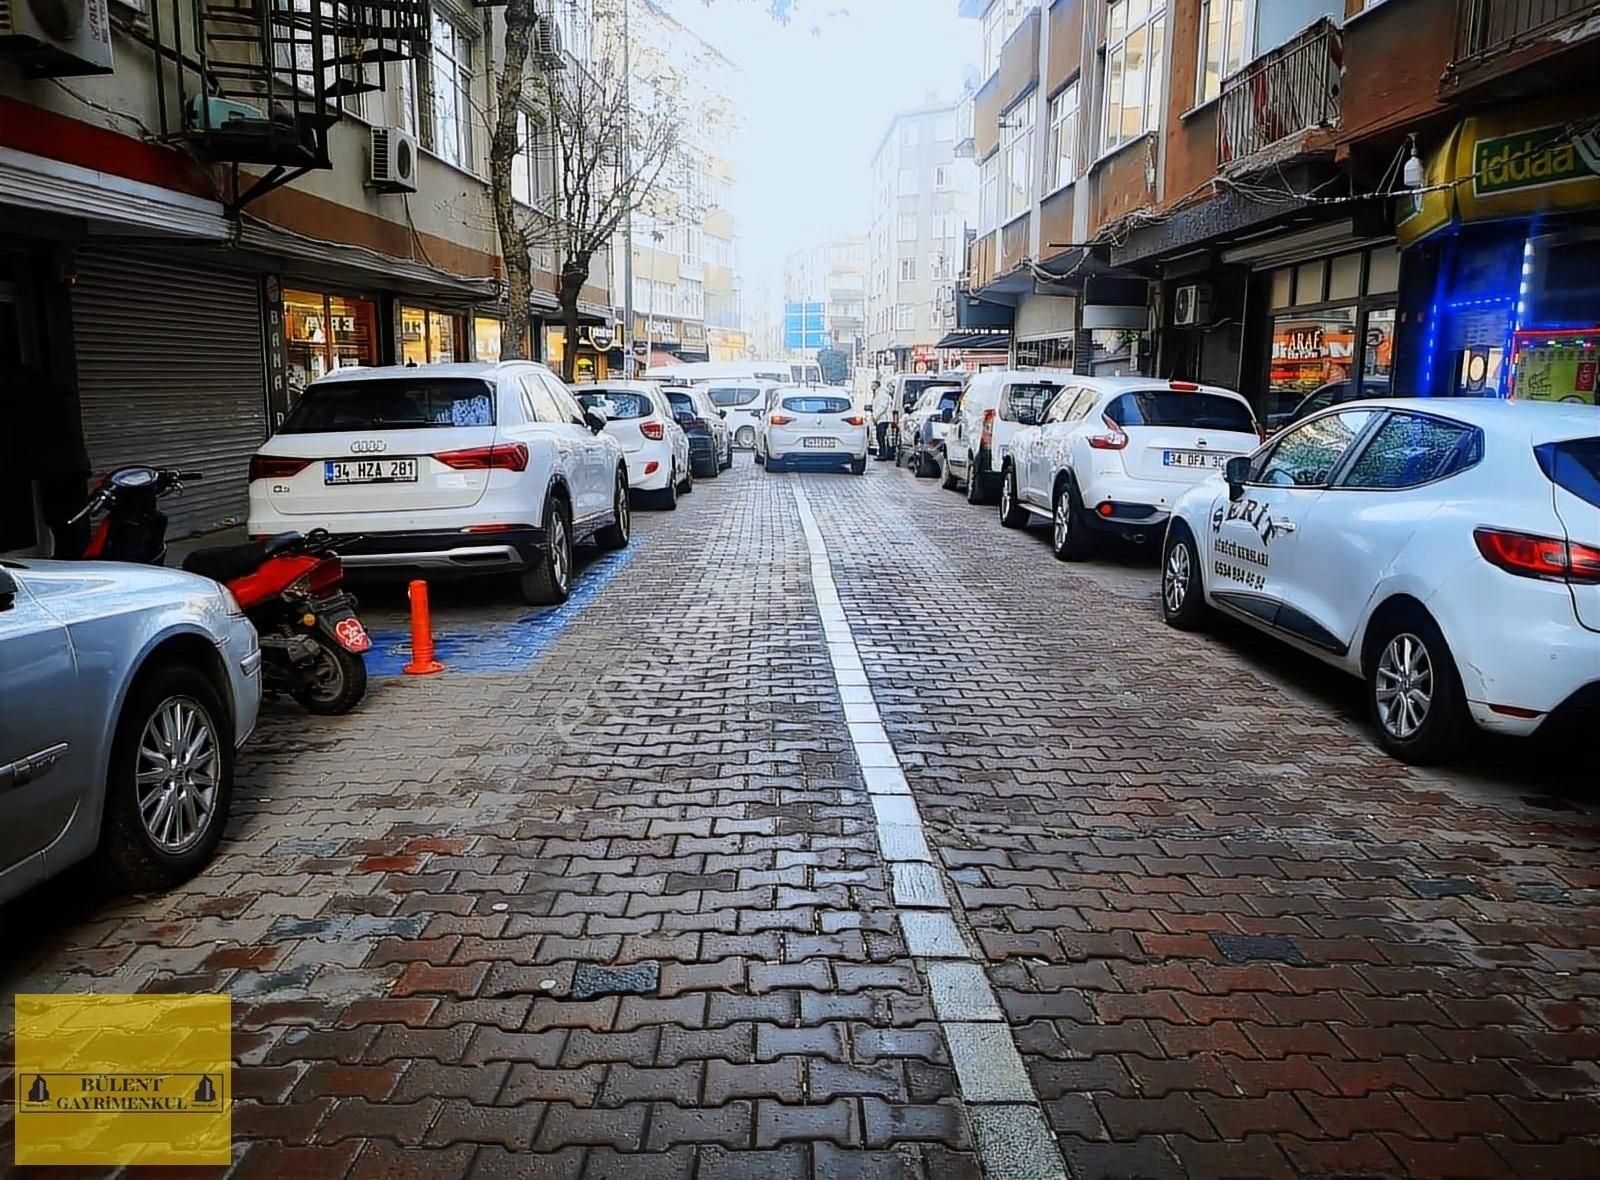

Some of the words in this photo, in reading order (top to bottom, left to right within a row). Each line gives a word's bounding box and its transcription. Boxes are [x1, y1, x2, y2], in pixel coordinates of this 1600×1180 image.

[1481, 141, 1575, 187] iddaa
[1170, 453, 1182, 464] 34
[334, 464, 350, 479] 34
[358, 462, 382, 478] HZA
[390, 461, 413, 476] 281
